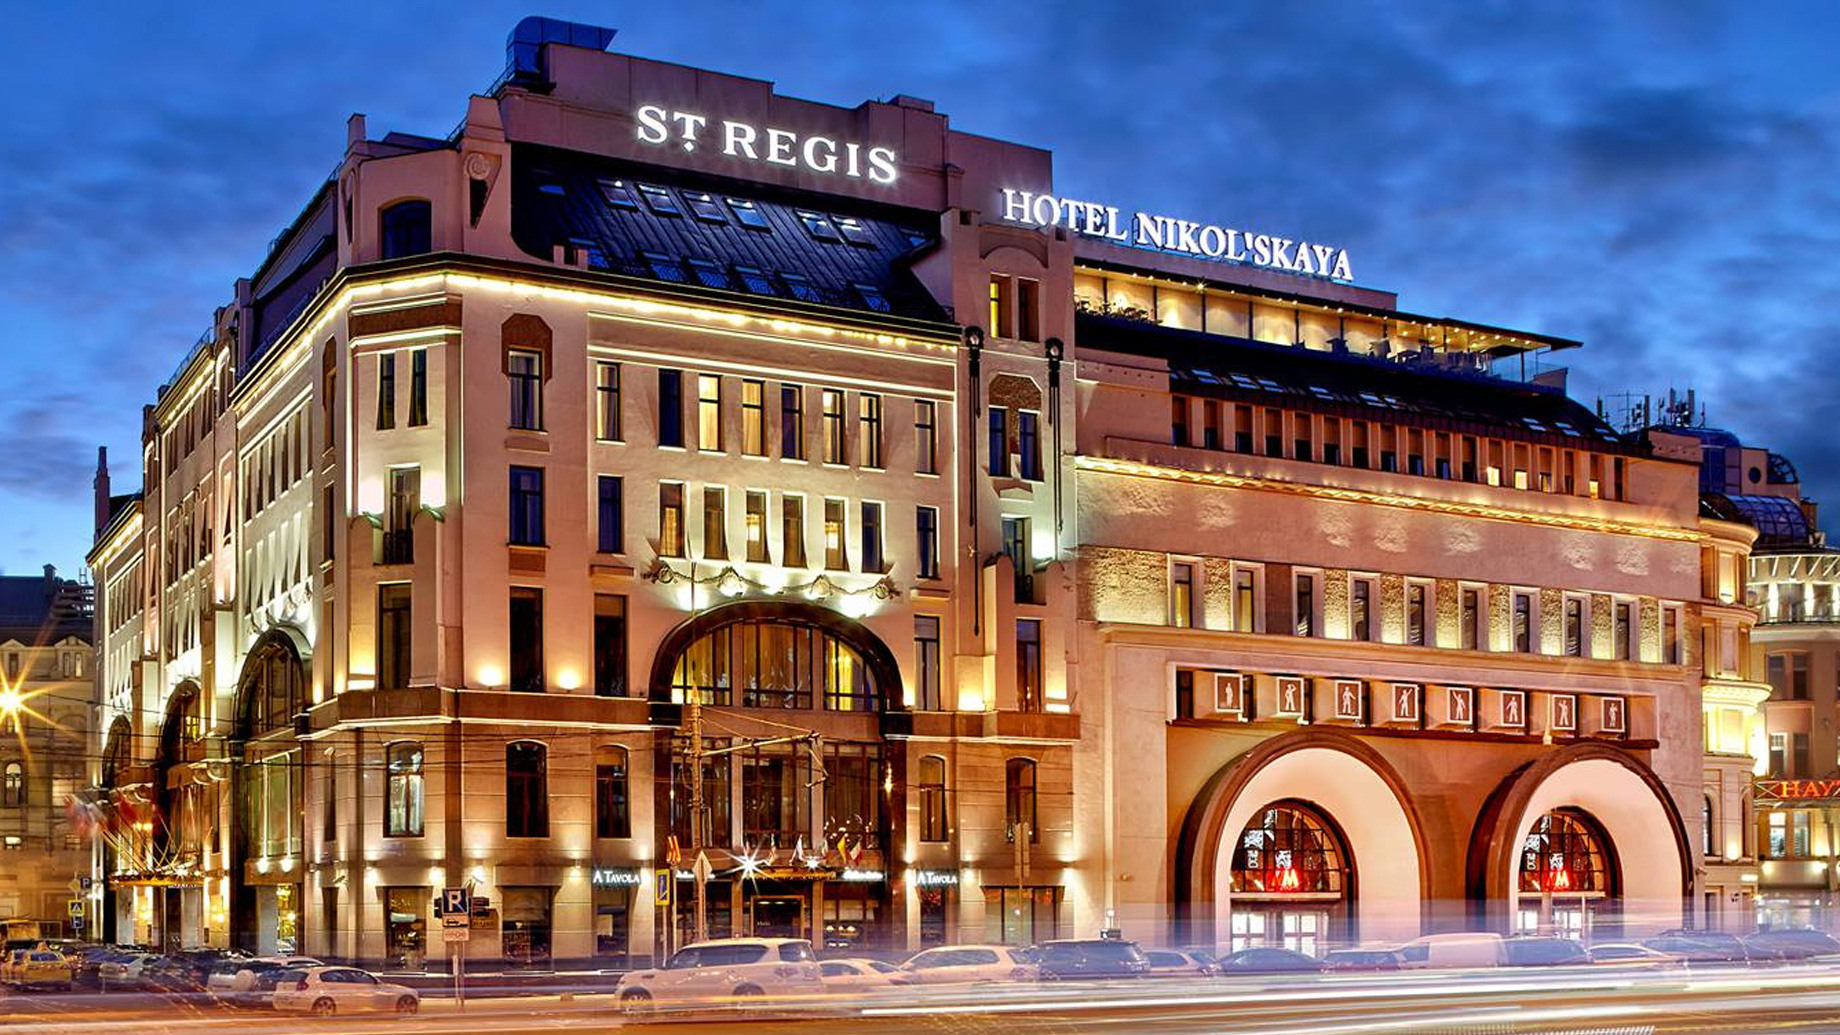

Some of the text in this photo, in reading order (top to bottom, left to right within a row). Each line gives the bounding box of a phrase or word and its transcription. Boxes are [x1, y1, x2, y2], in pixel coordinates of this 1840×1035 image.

[722, 120, 898, 185] REGIS
[1002, 188, 1354, 281] HOTEL NIKOL'SKAYA
[593, 870, 640, 884] A TAVOLA
[917, 872, 958, 884] A TAVOLA
